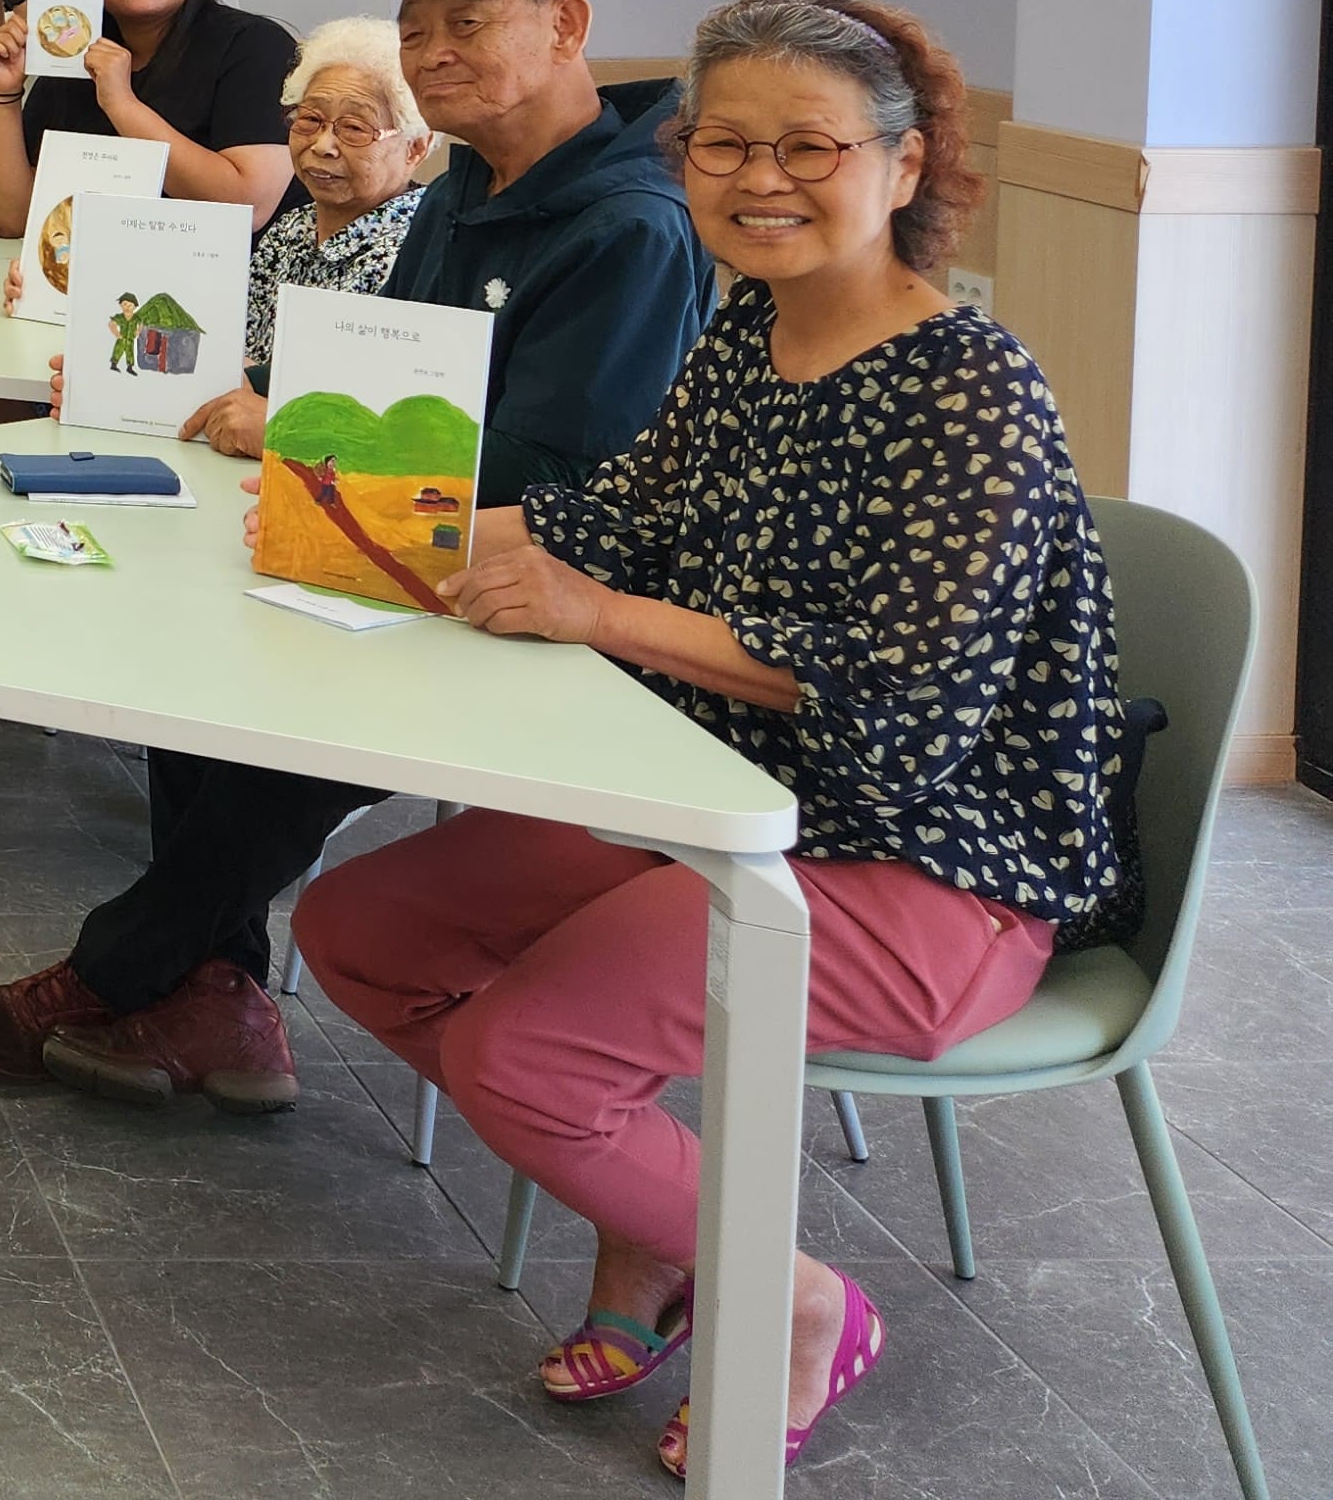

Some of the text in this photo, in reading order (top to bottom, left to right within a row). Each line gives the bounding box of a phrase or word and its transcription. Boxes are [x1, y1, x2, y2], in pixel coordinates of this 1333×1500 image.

[168, 222, 177, 232] 수
[179, 222, 197, 233] 있다
[334, 320, 355, 333] 나의
[380, 327, 422, 343] 행복으로
